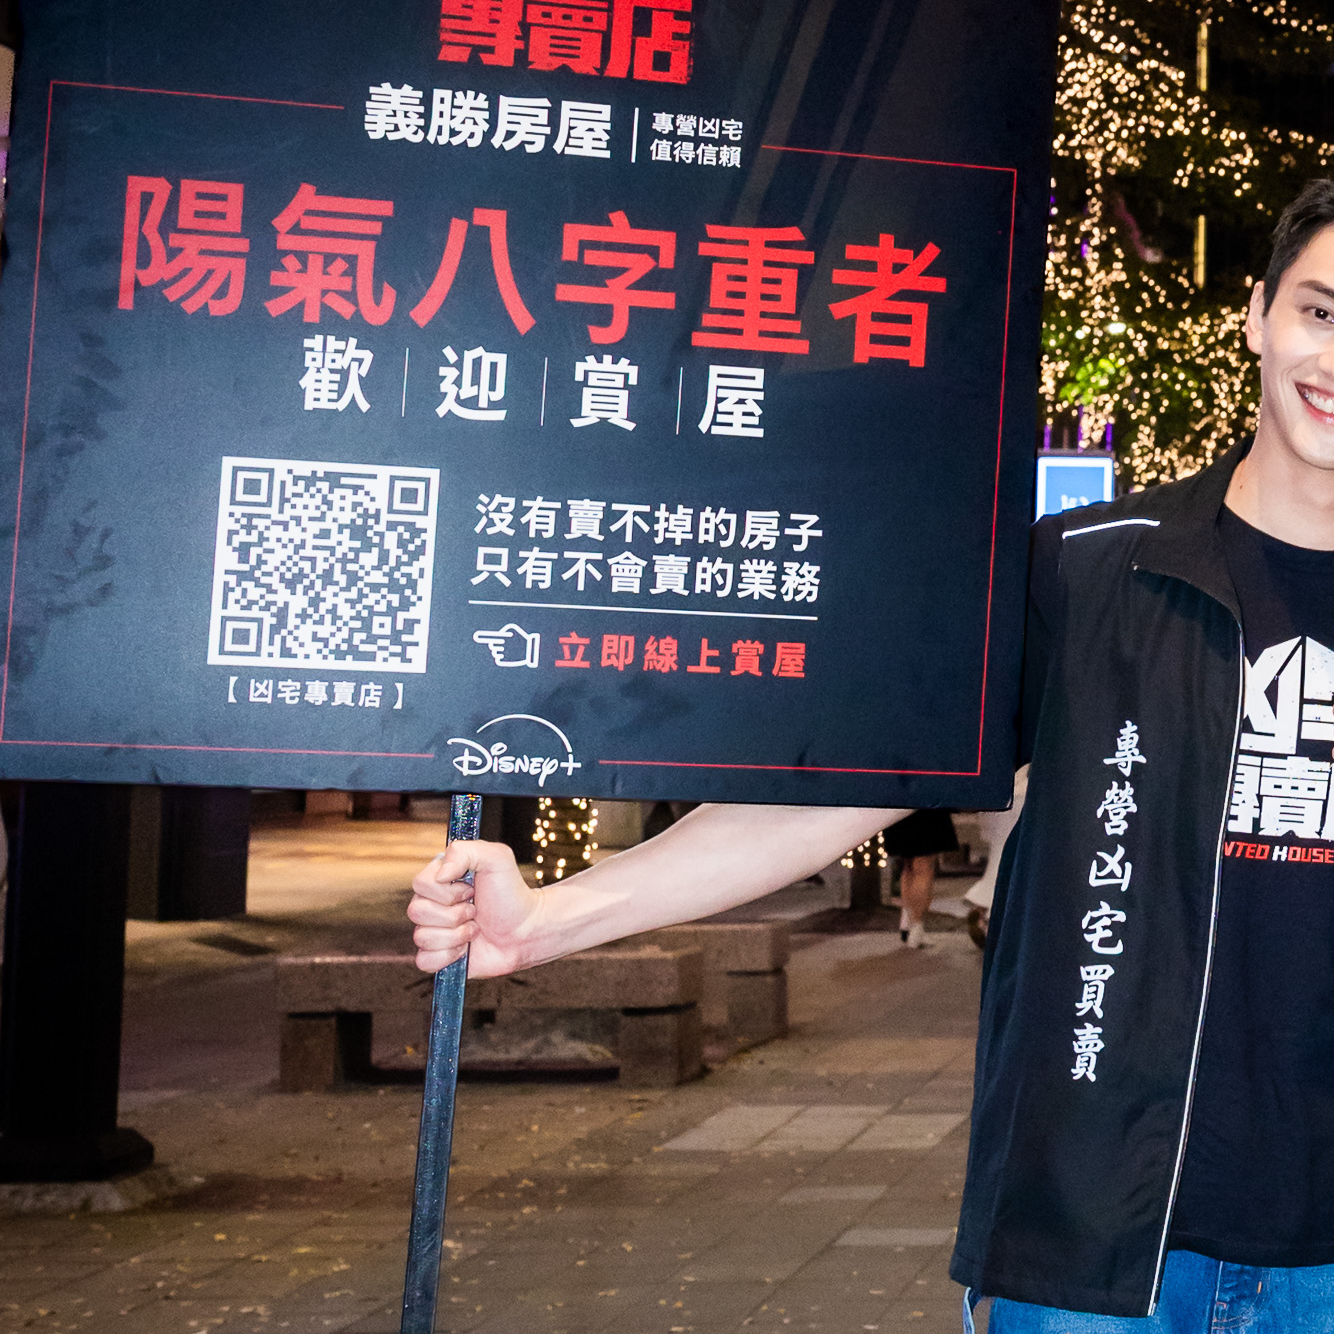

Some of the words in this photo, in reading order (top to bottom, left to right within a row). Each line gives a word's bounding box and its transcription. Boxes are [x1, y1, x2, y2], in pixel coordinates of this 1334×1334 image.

[364, 82, 612, 159] 義勝房屋
[652, 112, 743, 141] 專營凶宅
[650, 138, 742, 168] 值得信賴
[117, 175, 948, 369] 陽氣八字重者
[299, 334, 767, 438] 歡迎賞屋
[474, 493, 823, 553] 沒有賣不掉的房子
[469, 546, 821, 603] 只有不會賣的業務
[555, 631, 807, 678] 立即線上賞屋
[446, 736, 582, 787] Disney+
[1272, 845, 1334, 864] HOUSE
[1070, 720, 1147, 1083] 專營凶宅買賣
